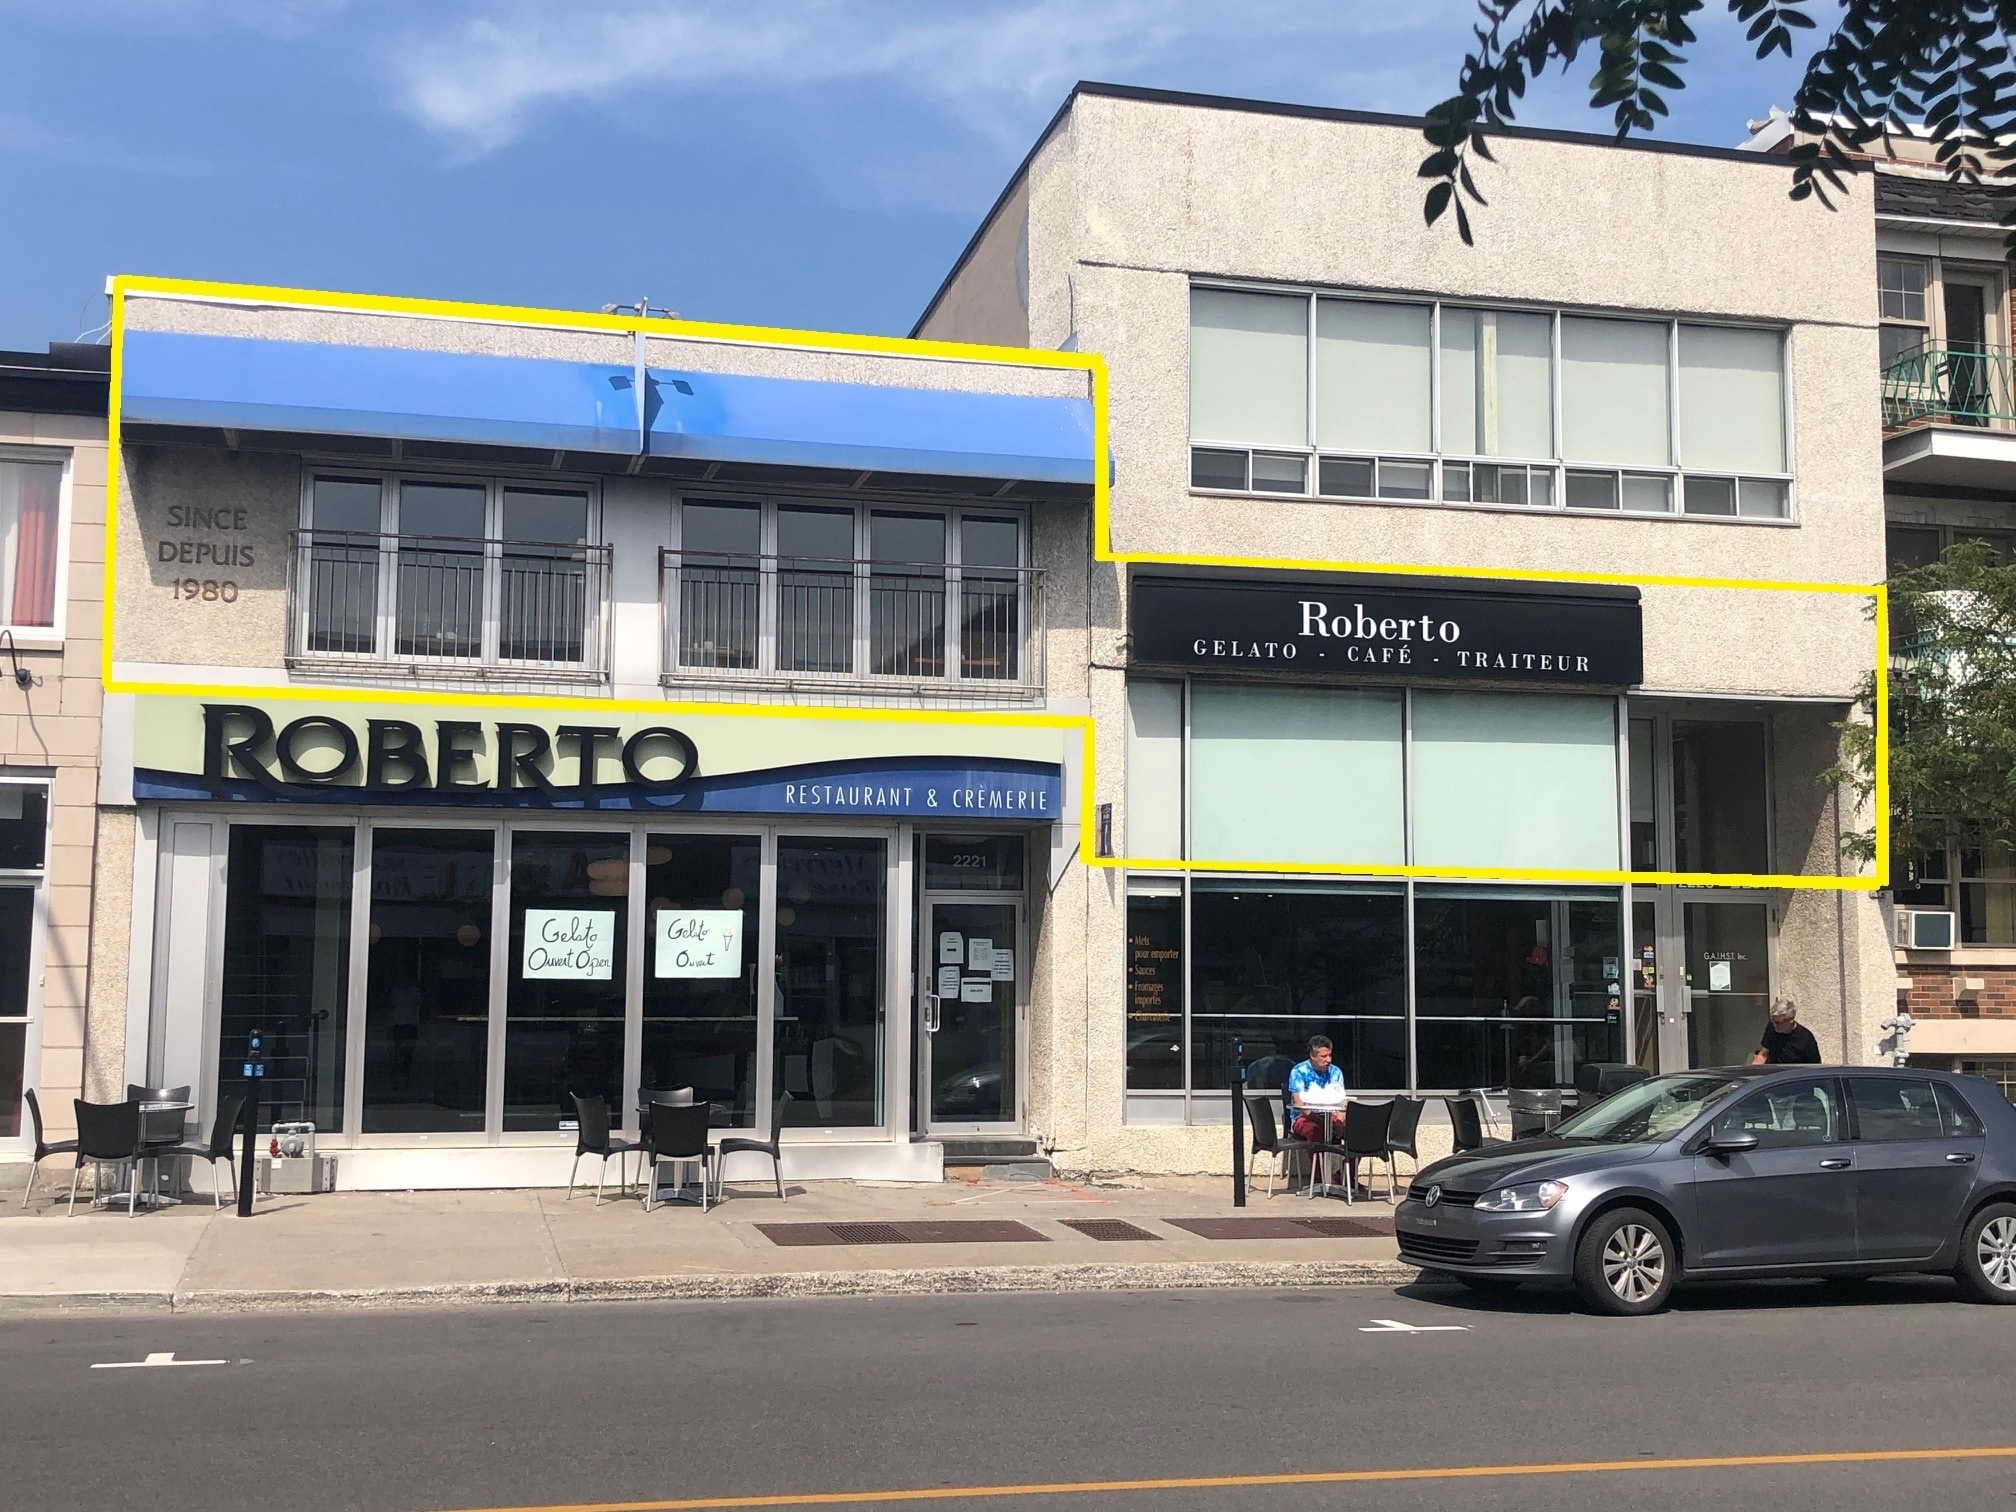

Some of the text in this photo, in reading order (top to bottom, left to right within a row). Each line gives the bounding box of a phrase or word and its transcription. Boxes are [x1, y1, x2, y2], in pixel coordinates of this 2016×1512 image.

[167, 504, 248, 531] SINCE
[158, 540, 255, 567] DEPUIS
[172, 577, 239, 603] 1980
[1297, 600, 1461, 643] Roberto
[1193, 638, 1299, 660] GELATO
[1347, 643, 1412, 665] CAFÉ
[1457, 650, 1591, 672] TRAITEUR
[200, 703, 699, 796] ROBERTO
[785, 783, 1048, 811] RESTAURANT & CRÈMERIE
[952, 854, 987, 868] 2221
[542, 916, 599, 949] Gelato
[667, 918, 711, 942] Gelato
[1134, 935, 1150, 946] Mets
[575, 948, 611, 976] Open
[1134, 950, 1179, 963] pour emporter
[1134, 964, 1156, 976] Sauces
[1134, 980, 1164, 995] Fromages
